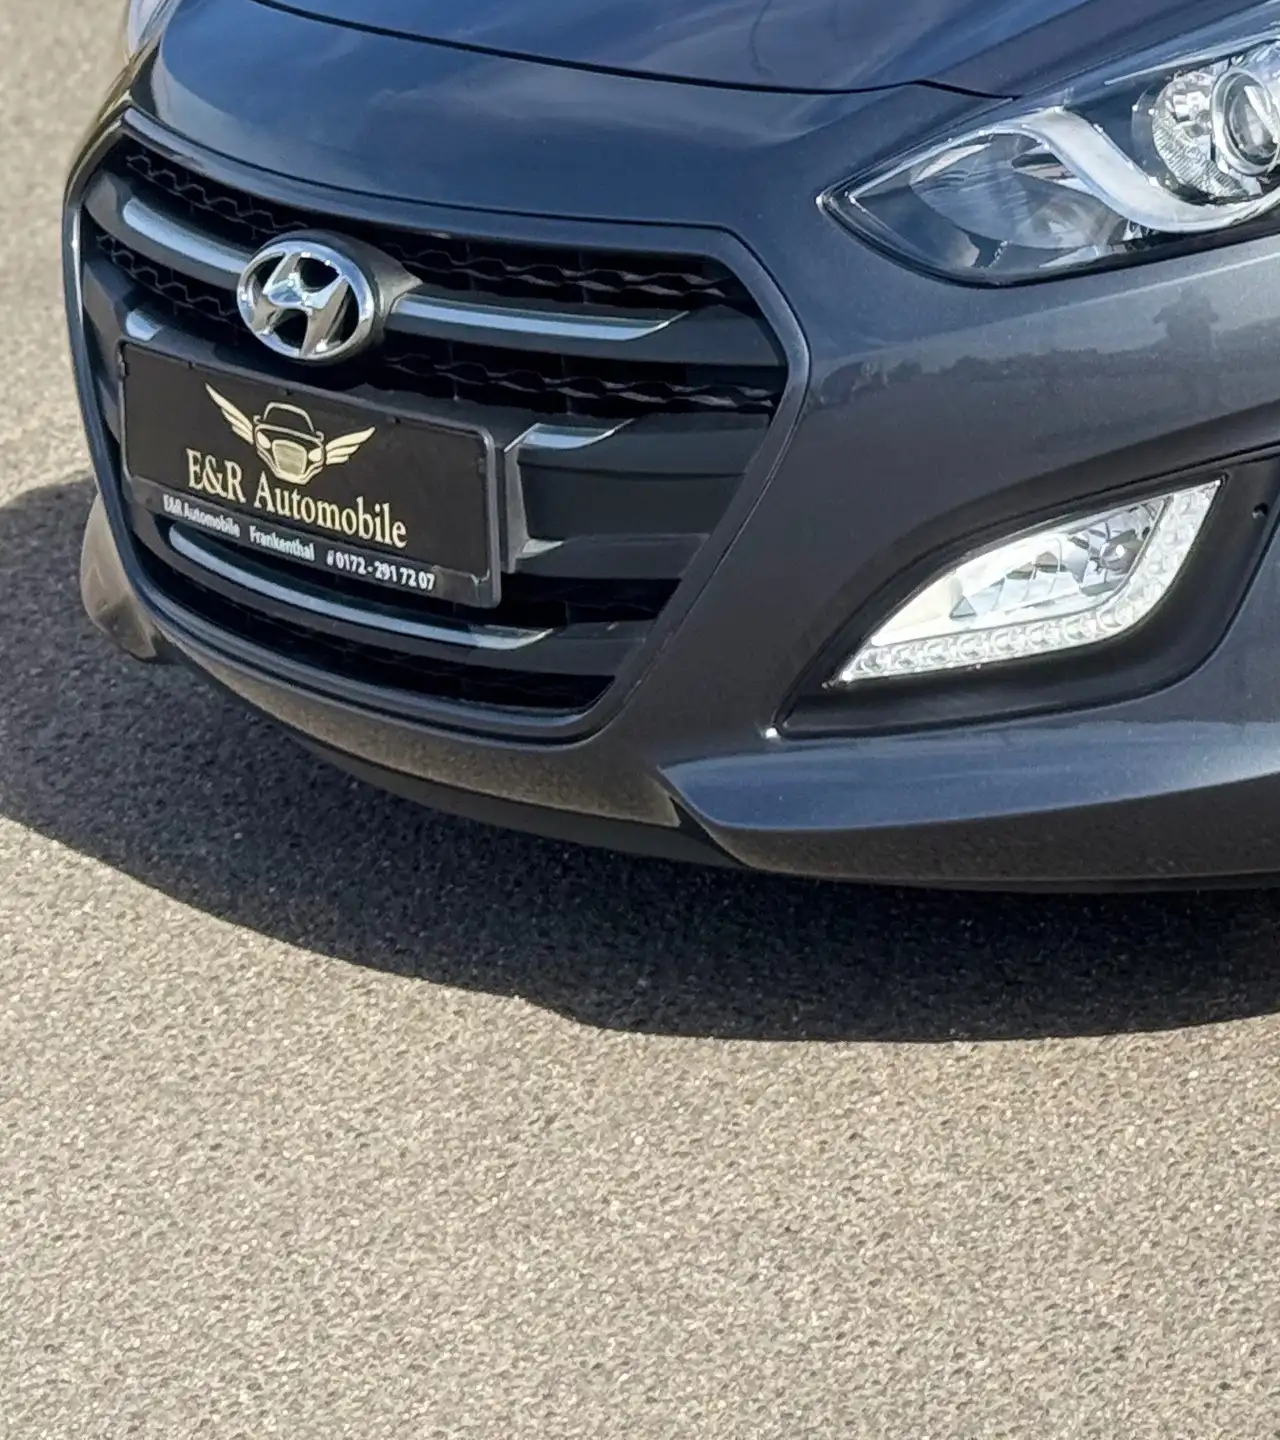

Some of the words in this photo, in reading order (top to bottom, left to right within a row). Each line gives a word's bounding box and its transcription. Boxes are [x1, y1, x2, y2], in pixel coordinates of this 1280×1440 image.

[184, 502, 241, 538] Automobile
[249, 524, 316, 562] Frankenthal
[186, 448, 246, 504] E&R
[254, 471, 407, 549] Automobile
